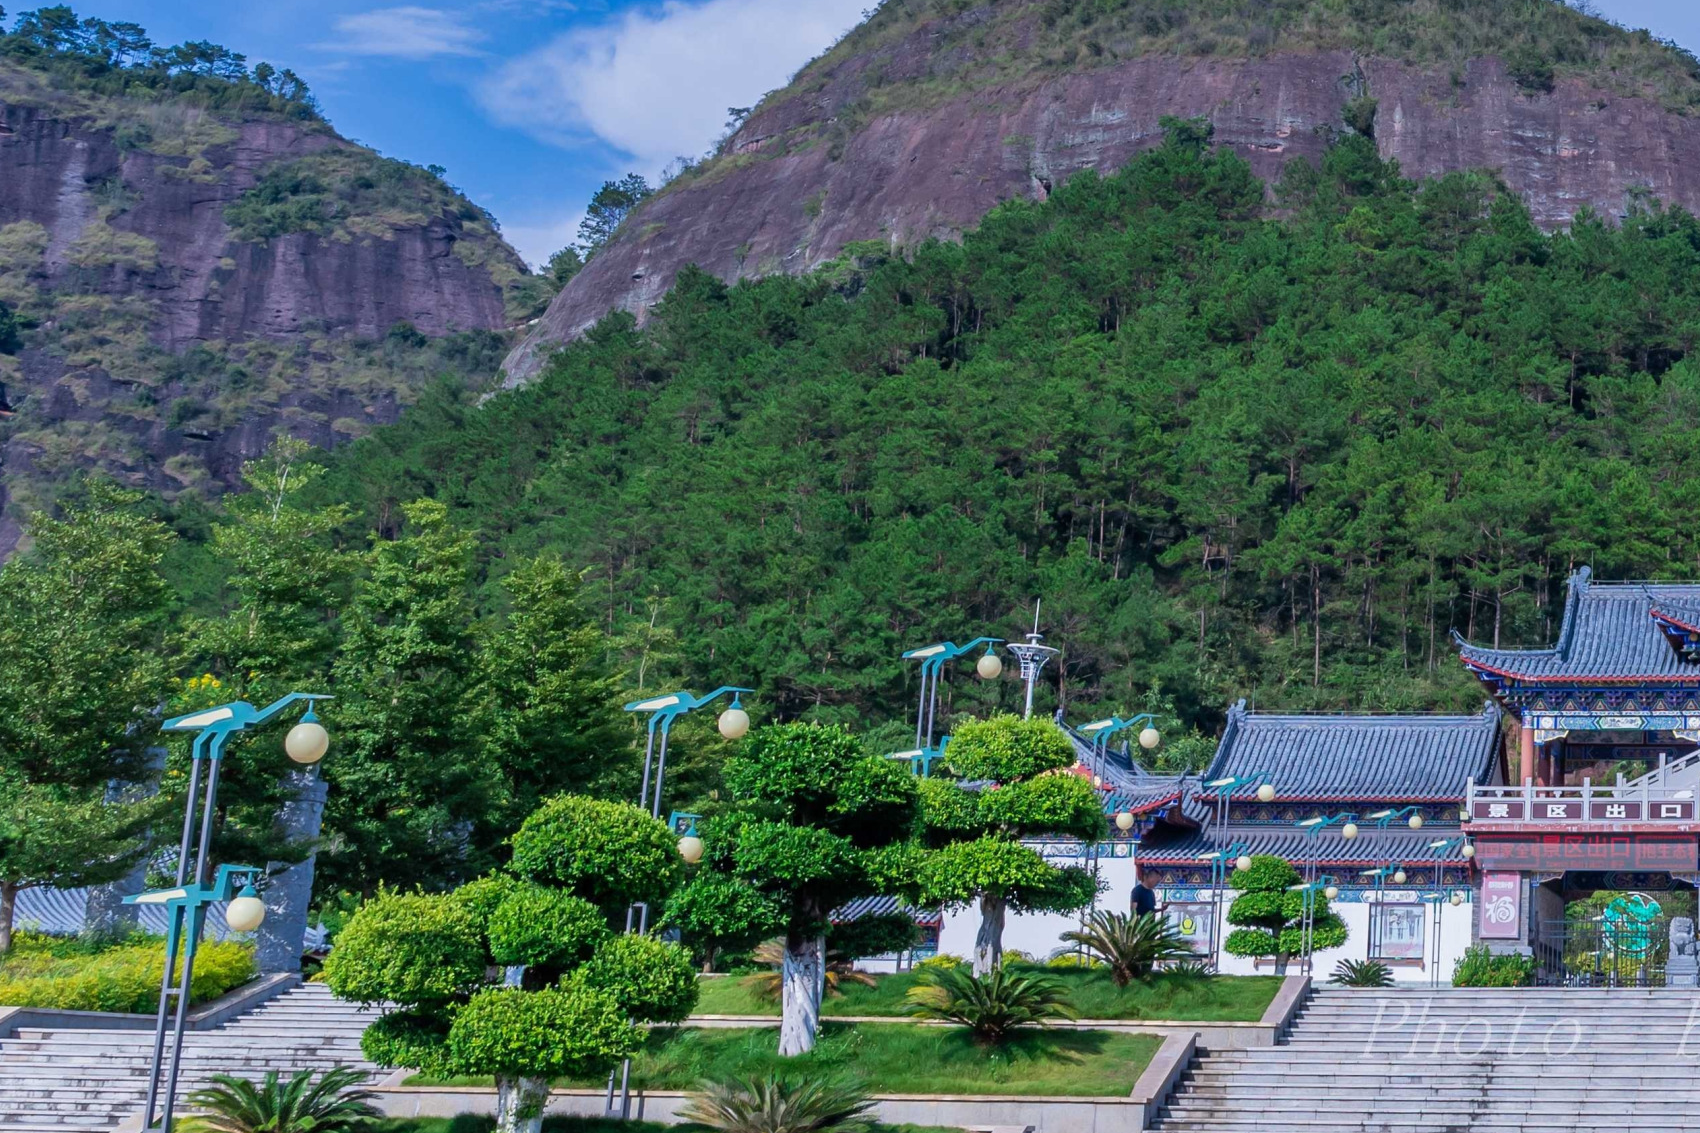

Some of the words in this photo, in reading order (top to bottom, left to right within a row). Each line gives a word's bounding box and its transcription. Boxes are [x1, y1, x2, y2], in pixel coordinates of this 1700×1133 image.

[1488, 804, 1682, 819] 景区出口
[1542, 835, 1631, 859] 景区出口
